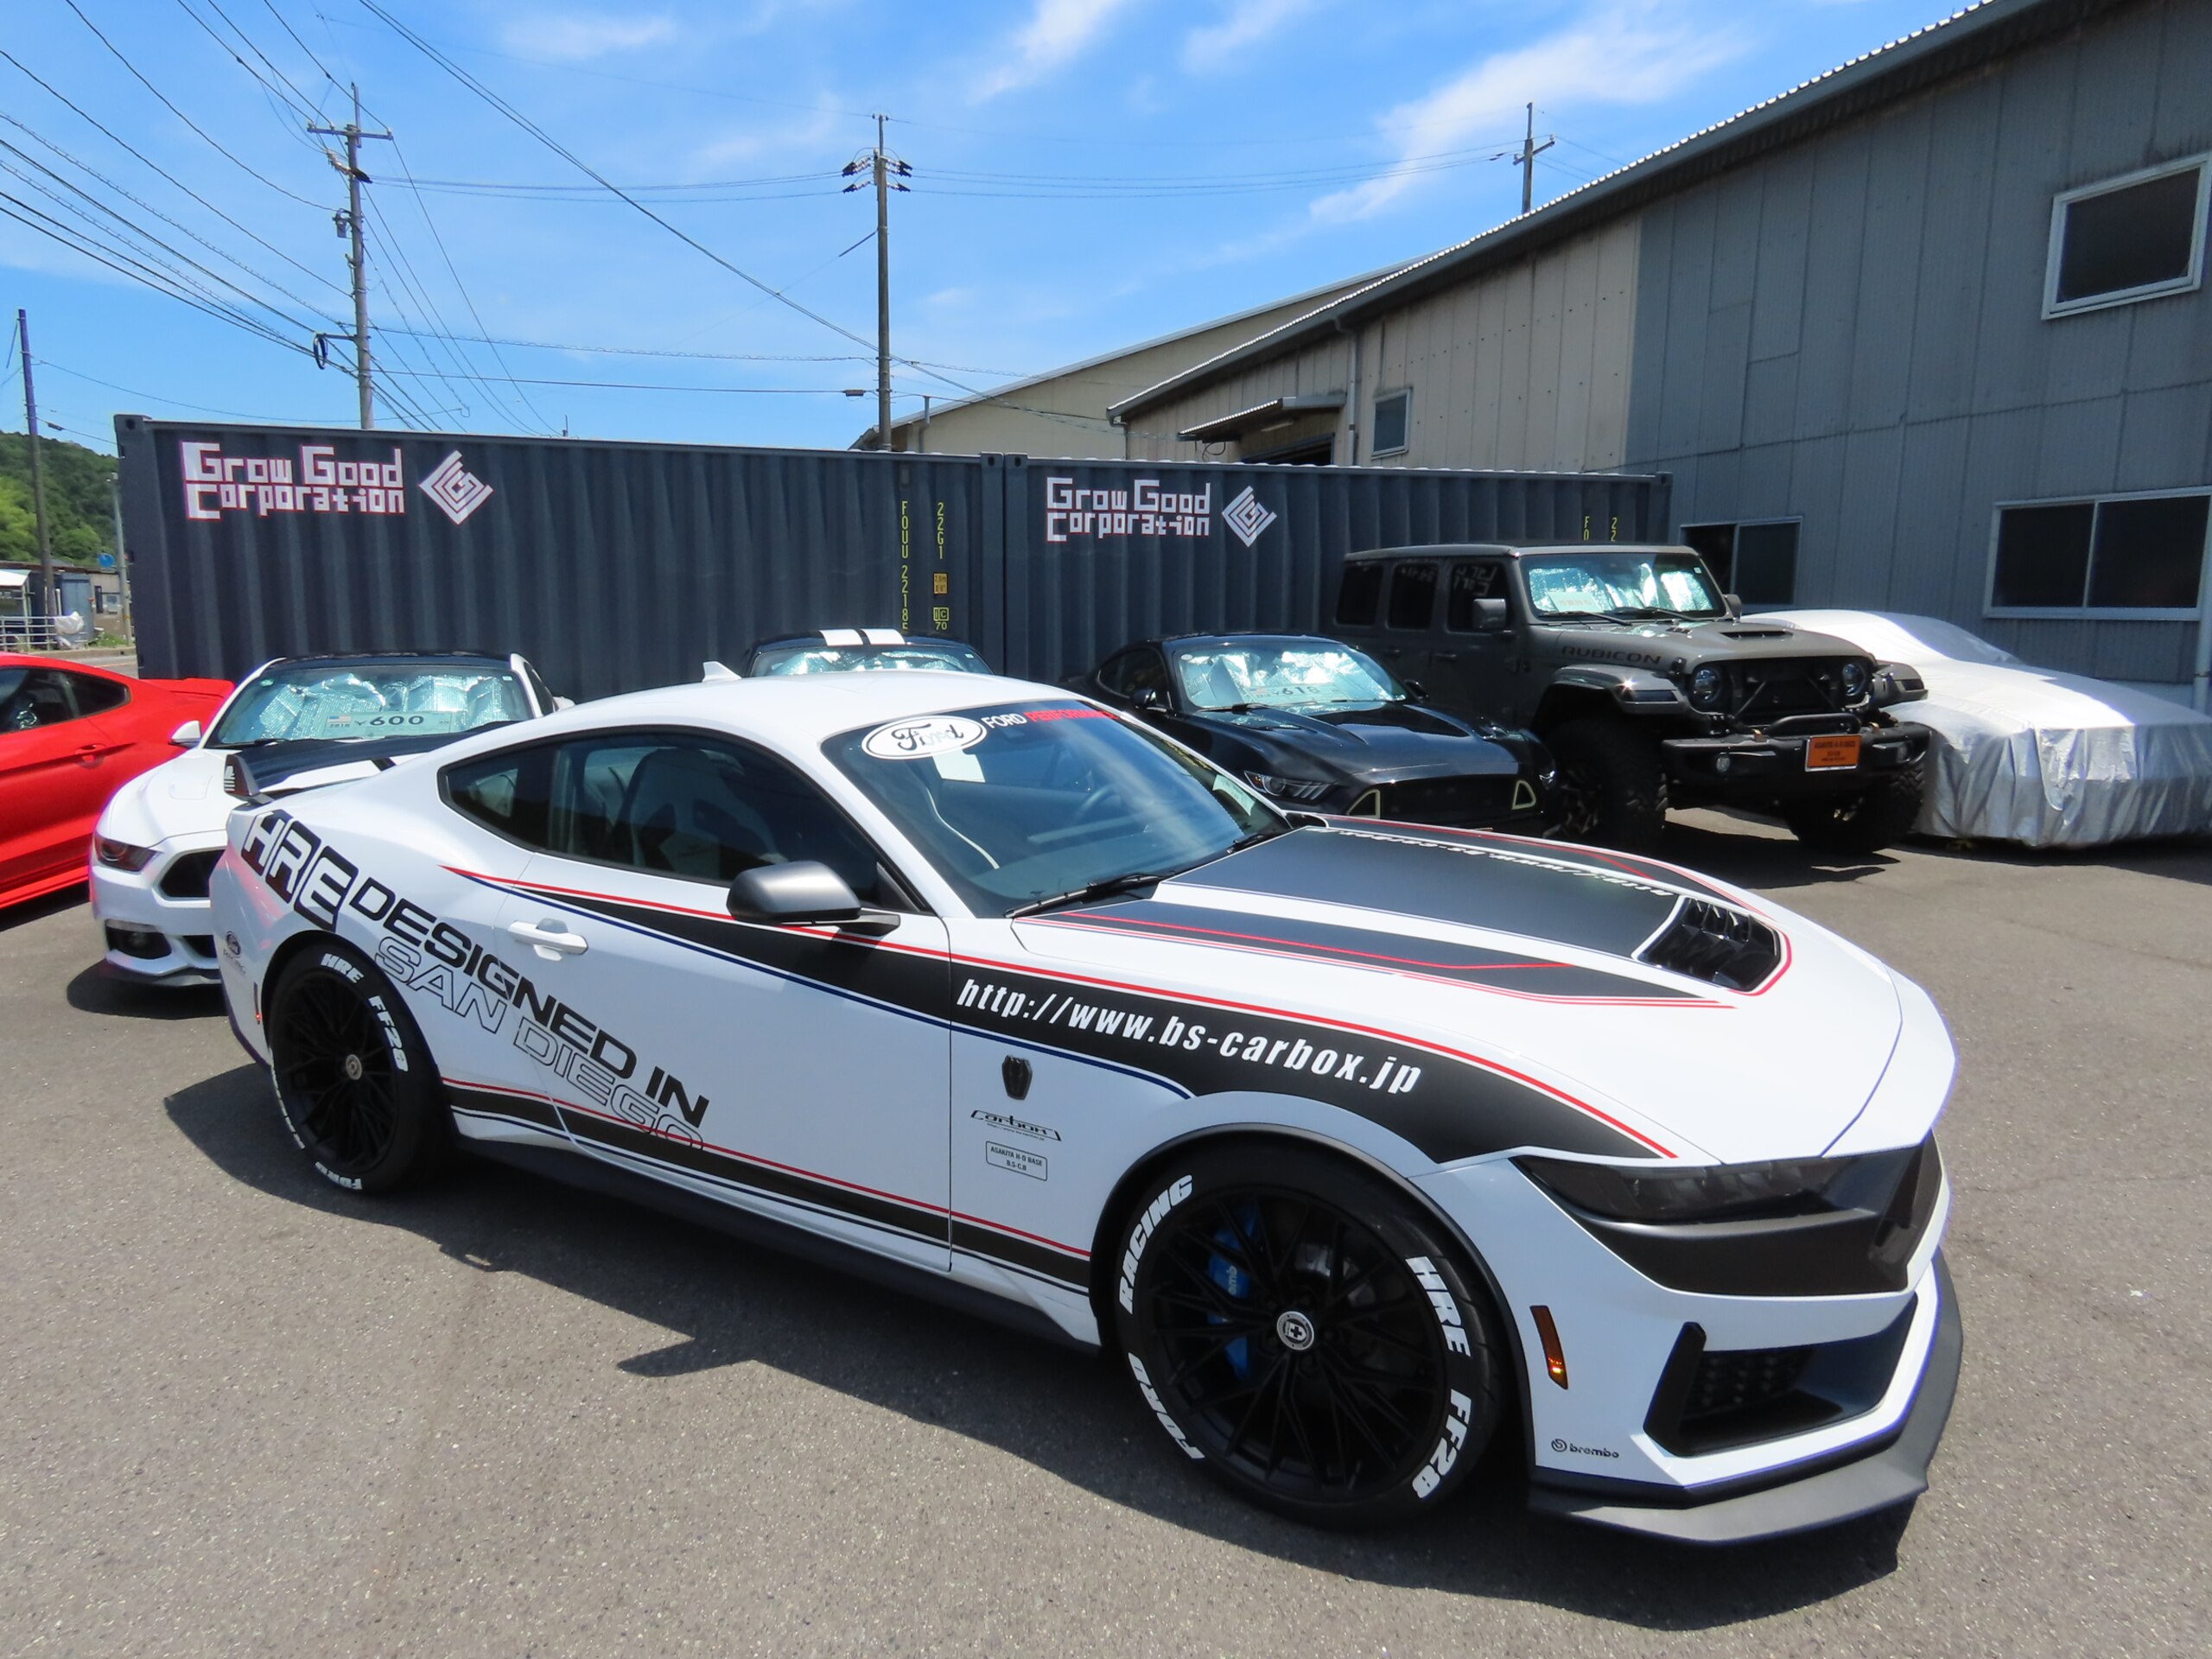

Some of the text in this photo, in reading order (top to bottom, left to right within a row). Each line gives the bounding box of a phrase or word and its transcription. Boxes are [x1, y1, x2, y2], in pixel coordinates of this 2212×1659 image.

[181, 442, 404, 487] Grow Good
[186, 483, 405, 519] Corporation
[1046, 477, 1211, 514] Grow Good
[1046, 512, 1209, 542] Corporation
[1561, 645, 1662, 664] RUBICON
[981, 713, 1027, 728] FORD
[241, 809, 359, 933] HRE
[321, 953, 364, 983] HRE
[375, 936, 508, 1034] SAN
[348, 877, 709, 1128] DESIGNED IN
[957, 979, 1422, 1095] http://www.bs-carbox.jp
[1119, 1174, 1192, 1314] RACING
[1405, 1255, 1471, 1499] HRE FF28
[1569, 1442, 1619, 1459] brembo
